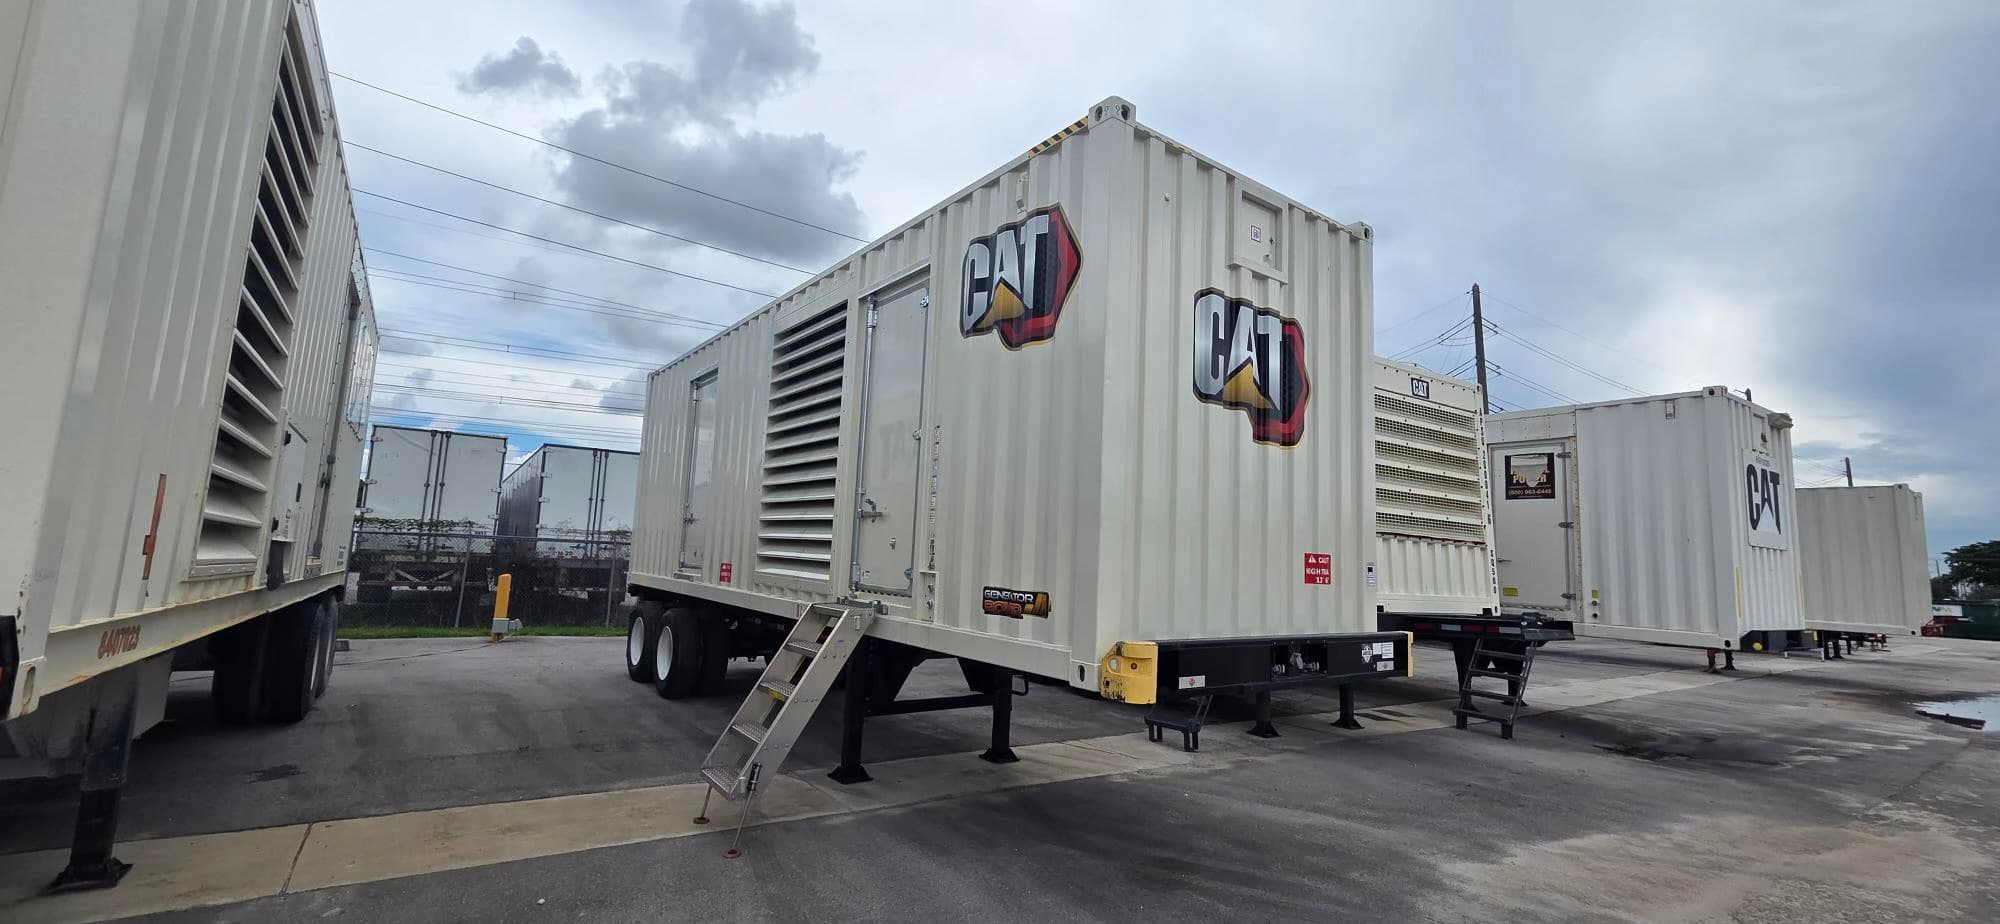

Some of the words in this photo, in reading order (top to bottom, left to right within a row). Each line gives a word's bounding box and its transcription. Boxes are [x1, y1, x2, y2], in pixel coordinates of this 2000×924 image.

[963, 214, 1049, 331] CAT
[1194, 293, 1283, 411] CAT
[1412, 379, 1428, 397] CAT
[1746, 463, 1781, 535] CAT
